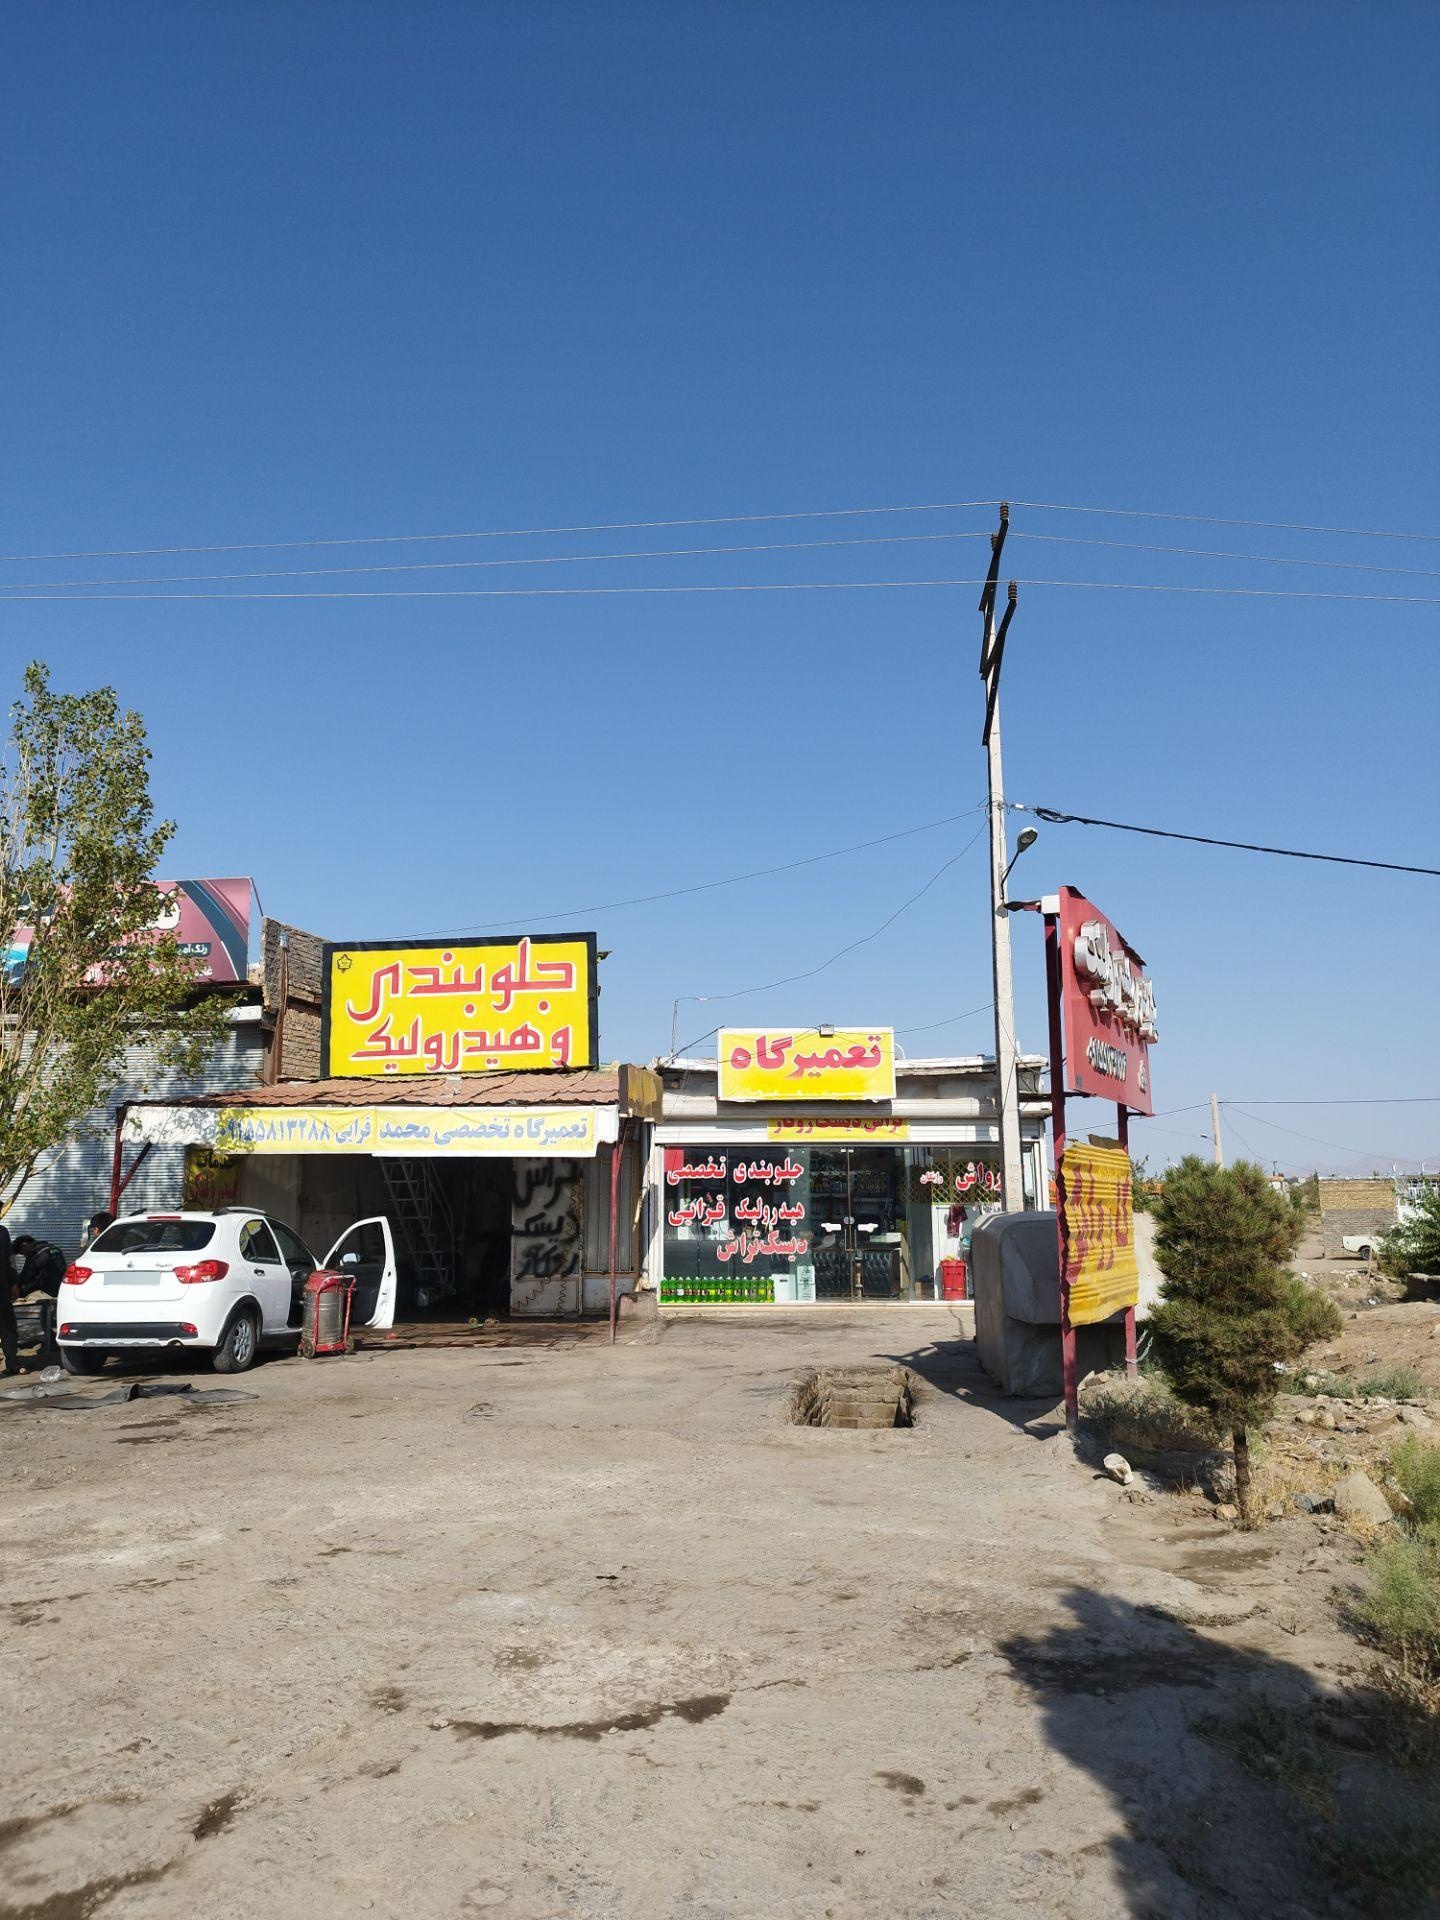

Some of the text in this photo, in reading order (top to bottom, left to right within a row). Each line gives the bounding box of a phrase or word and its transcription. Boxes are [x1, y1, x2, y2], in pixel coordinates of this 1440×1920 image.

[346, 936, 575, 1023] جلوبندی
[349, 1013, 572, 1073] و هیدرولیک
[730, 1034, 882, 1080] تعمیرگاه
[379, 1120, 430, 1140] محمد
[433, 1117, 510, 1146] تخصصی
[513, 1117, 588, 1146] تعمیرگاه
[666, 1155, 805, 1187] جلوبندی تخصصی
[955, 1161, 1002, 1191] رواش
[734, 1196, 806, 1227] هیدرولیک
